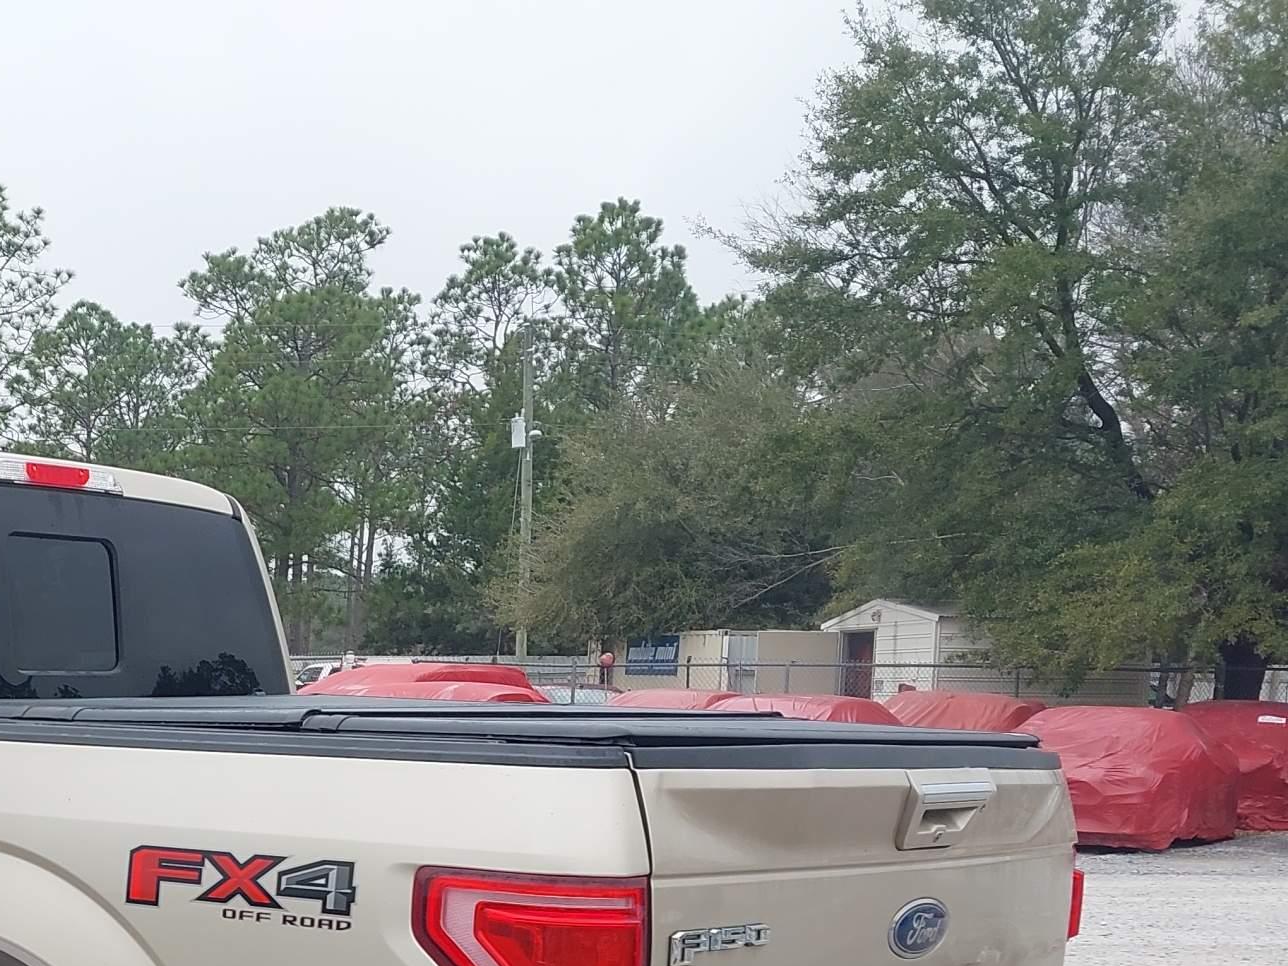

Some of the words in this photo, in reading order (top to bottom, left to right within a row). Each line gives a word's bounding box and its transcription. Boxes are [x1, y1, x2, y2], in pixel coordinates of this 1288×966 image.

[125, 845, 357, 916] FX4
[222, 908, 272, 922] OFF
[282, 914, 352, 931] ROAD
[907, 912, 942, 945] Ford
